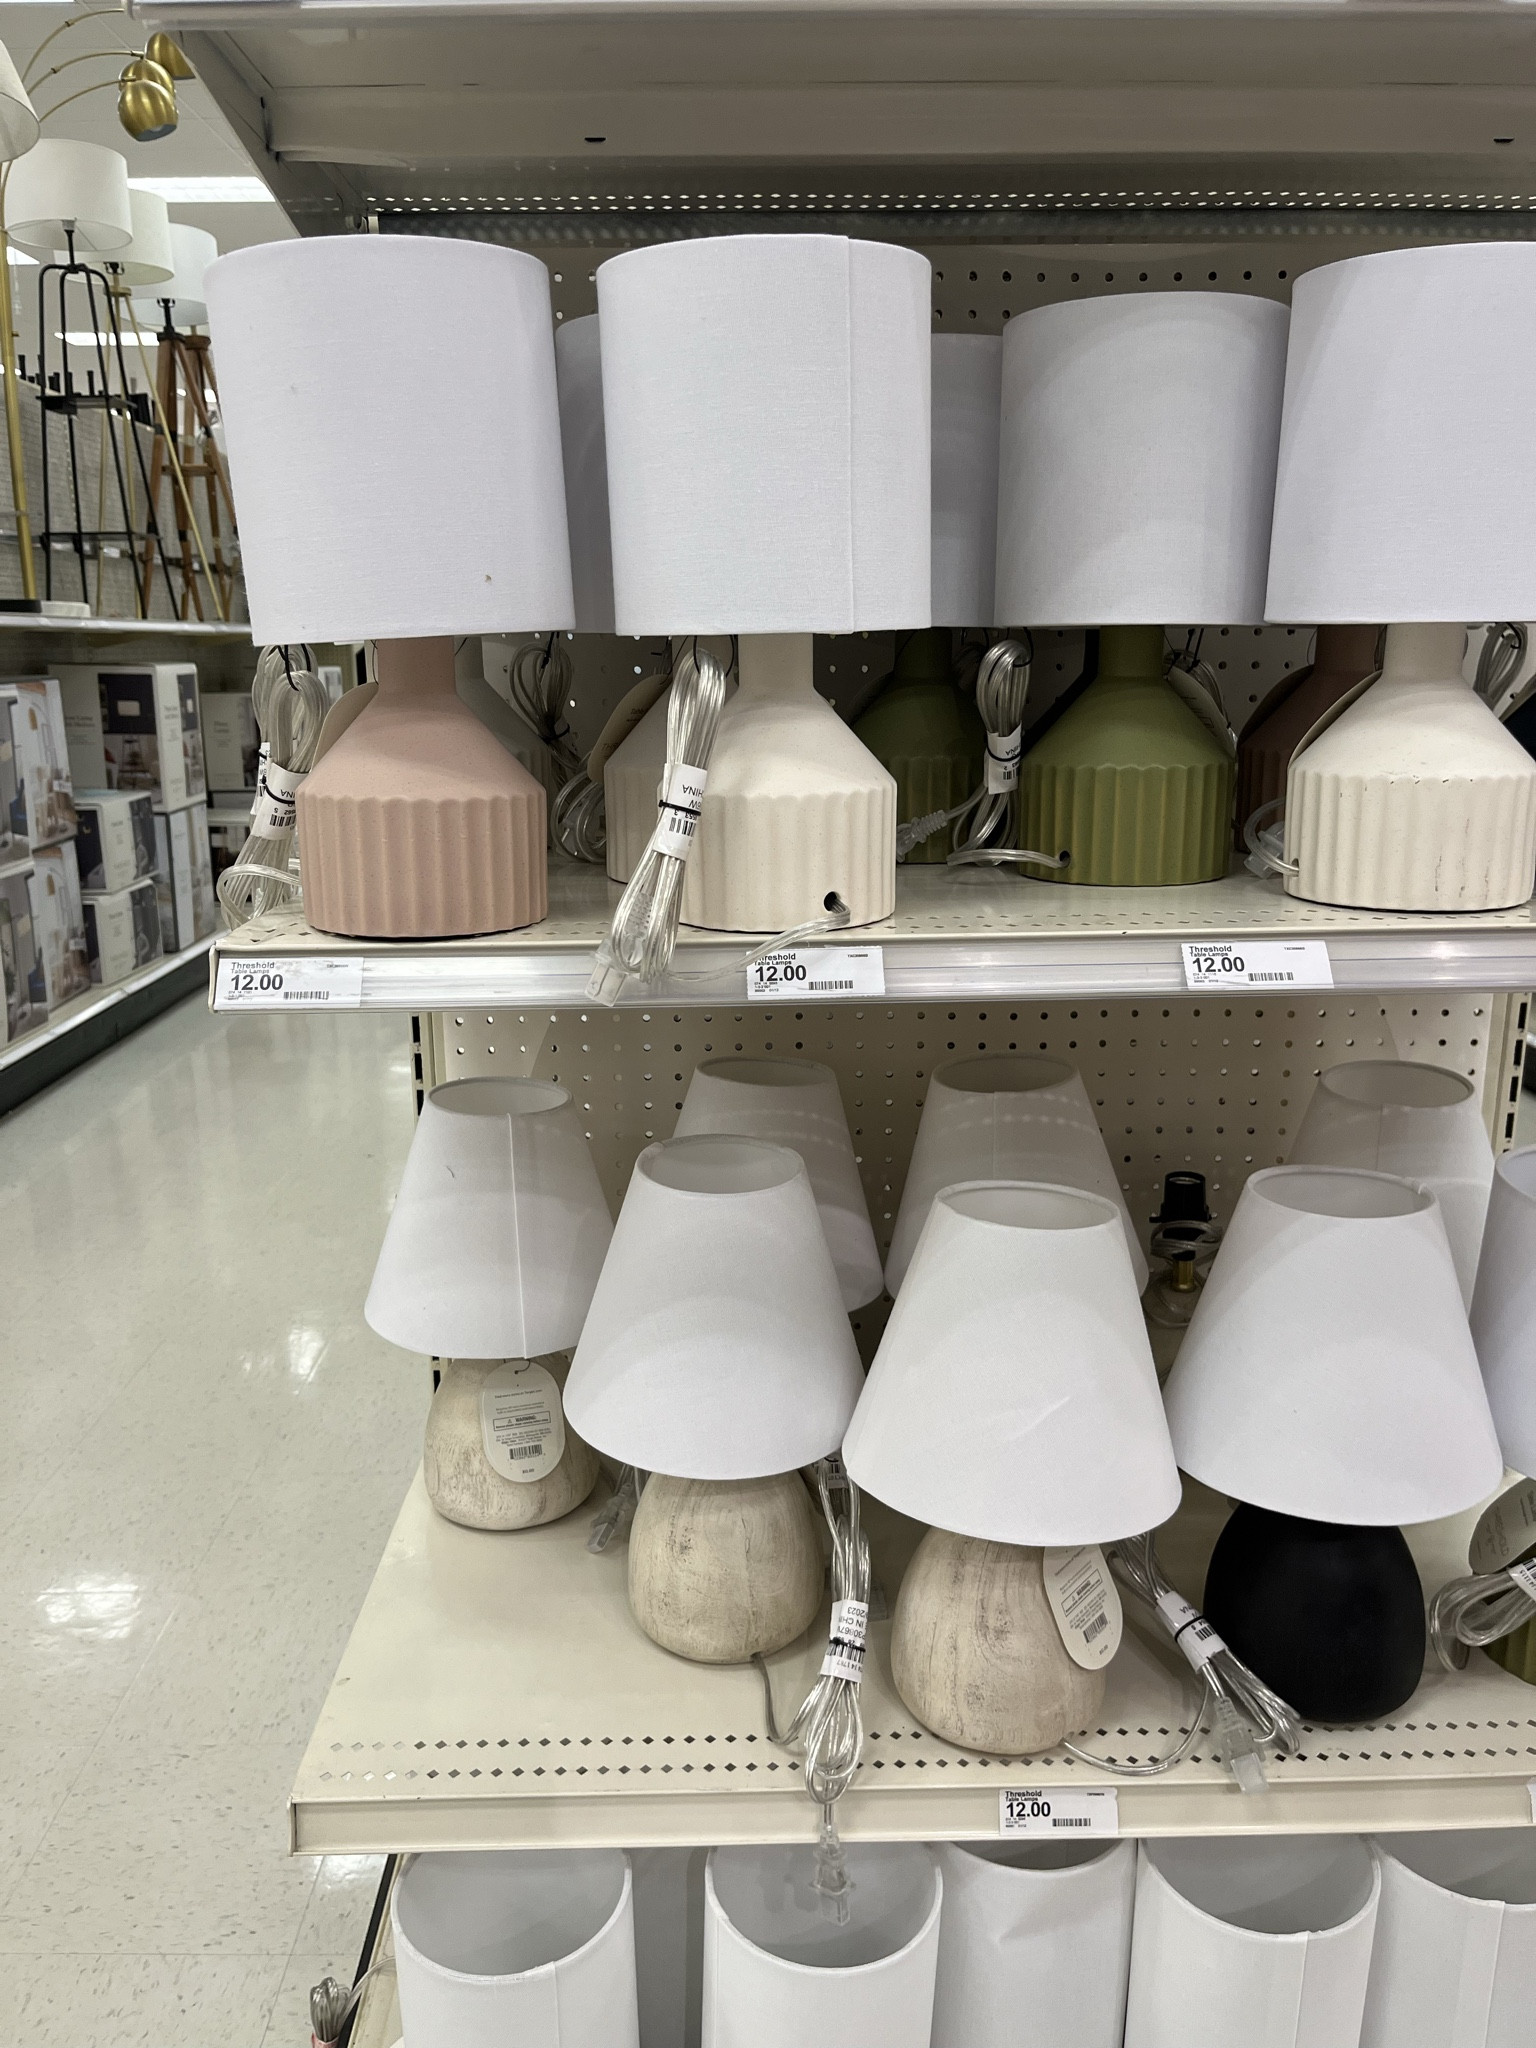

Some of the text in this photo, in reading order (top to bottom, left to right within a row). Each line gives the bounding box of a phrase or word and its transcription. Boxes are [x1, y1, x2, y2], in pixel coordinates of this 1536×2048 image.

[280, 789, 295, 799] INA
[682, 784, 704, 798] HINA
[1192, 956, 1245, 973] 12.00
[755, 965, 807, 982] 12.00
[231, 974, 284, 991] 12.00
[847, 1606, 867, 1618] 2023
[856, 1618, 865, 1628] IN
[1006, 1801, 1051, 1818] 12.00
